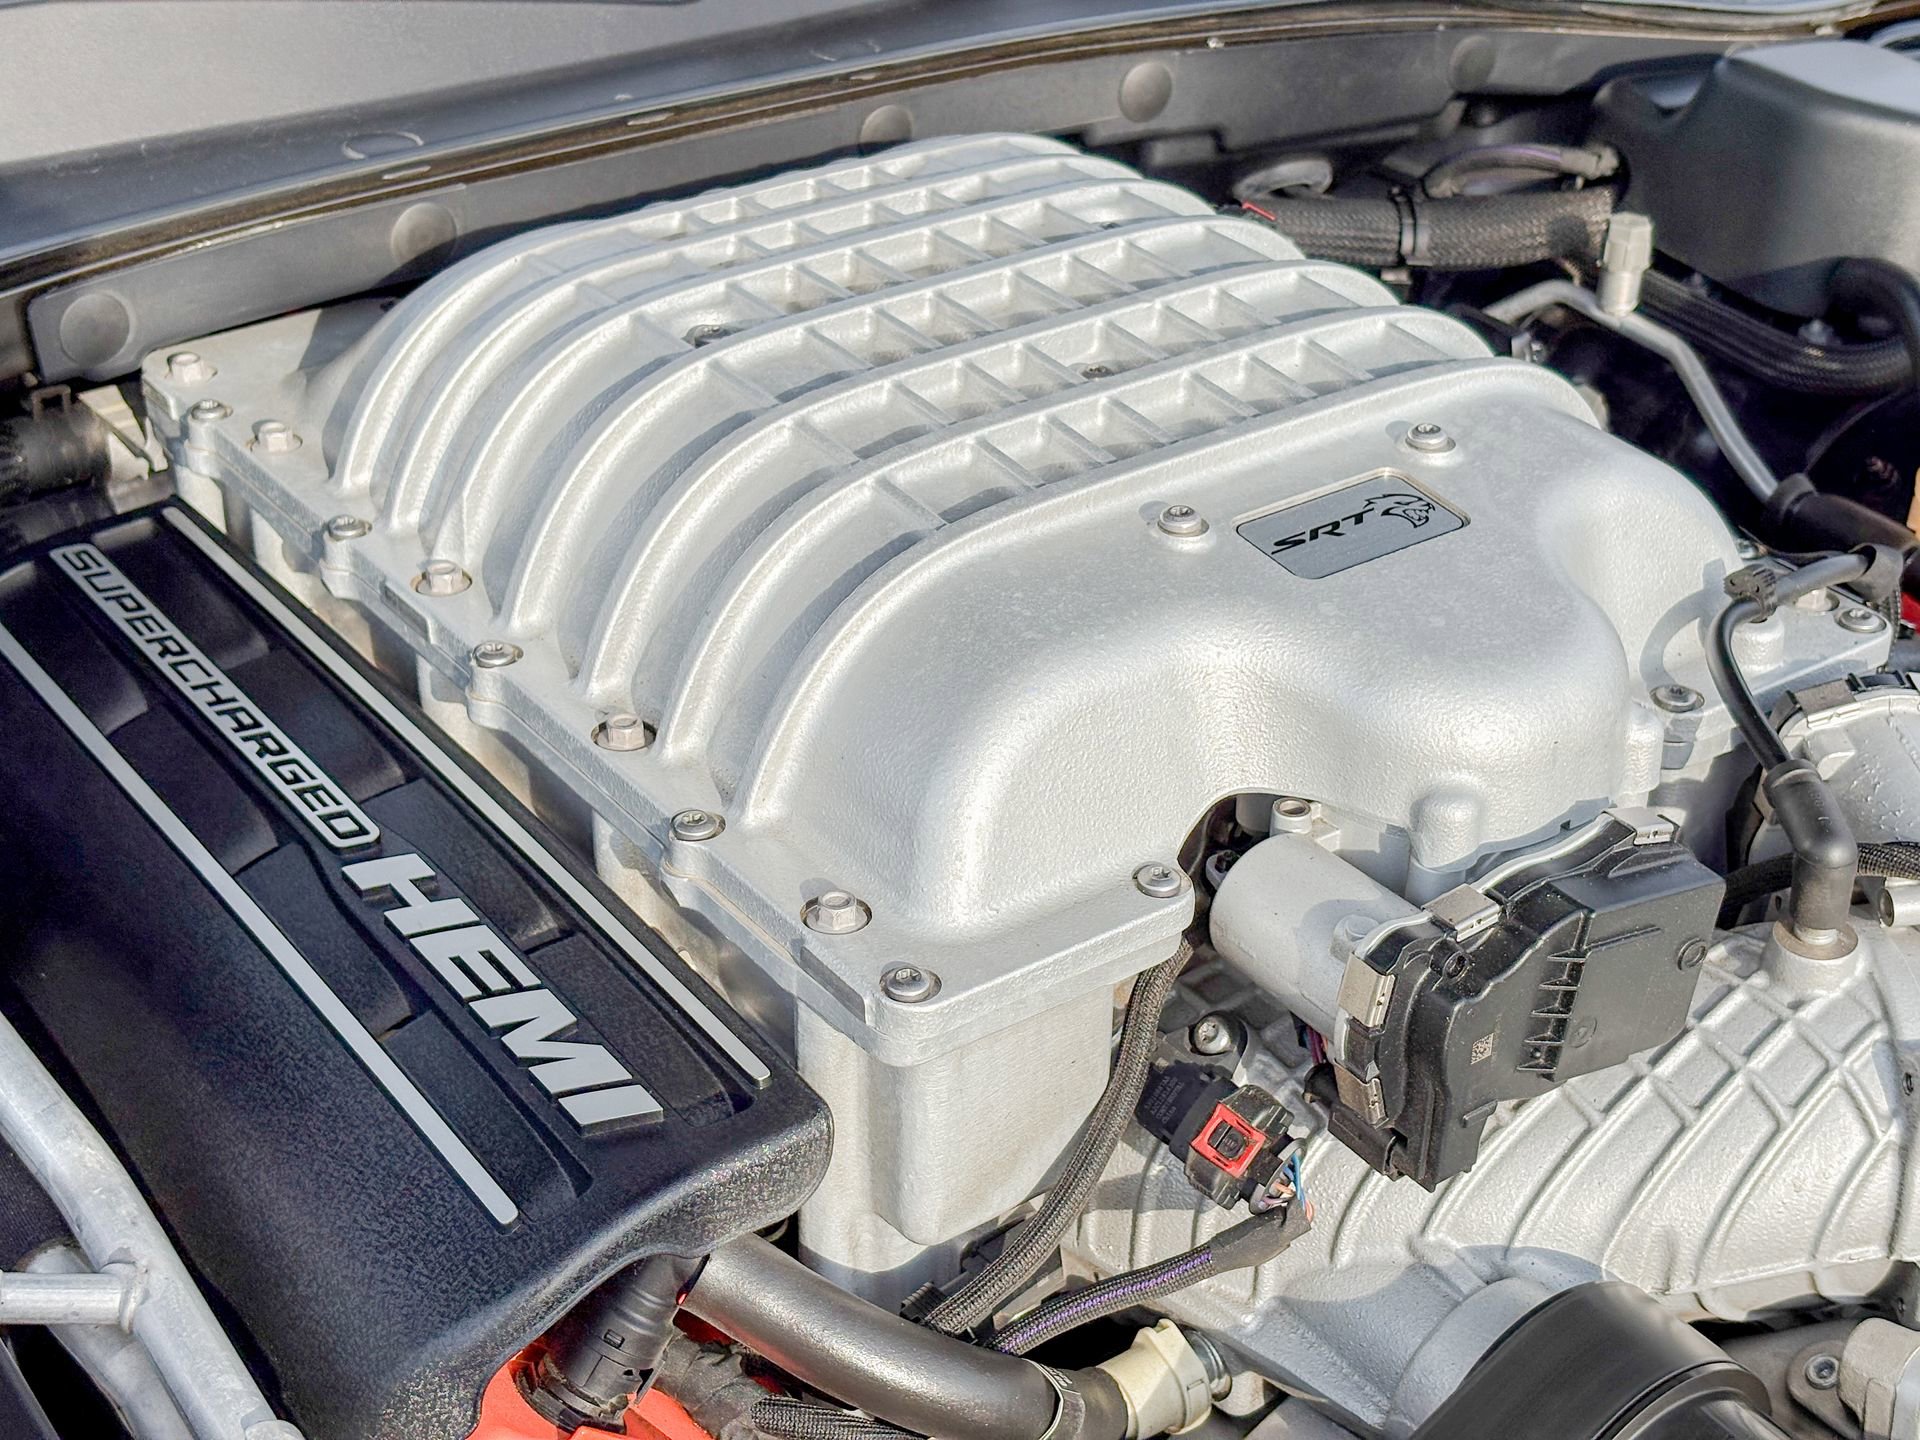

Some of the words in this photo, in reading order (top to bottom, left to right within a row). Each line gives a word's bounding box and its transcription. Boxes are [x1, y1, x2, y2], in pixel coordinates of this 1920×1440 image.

[1271, 508, 1375, 555] SRT
[61, 549, 371, 840] SUPERCHARGED
[341, 853, 664, 1126] HEMI
